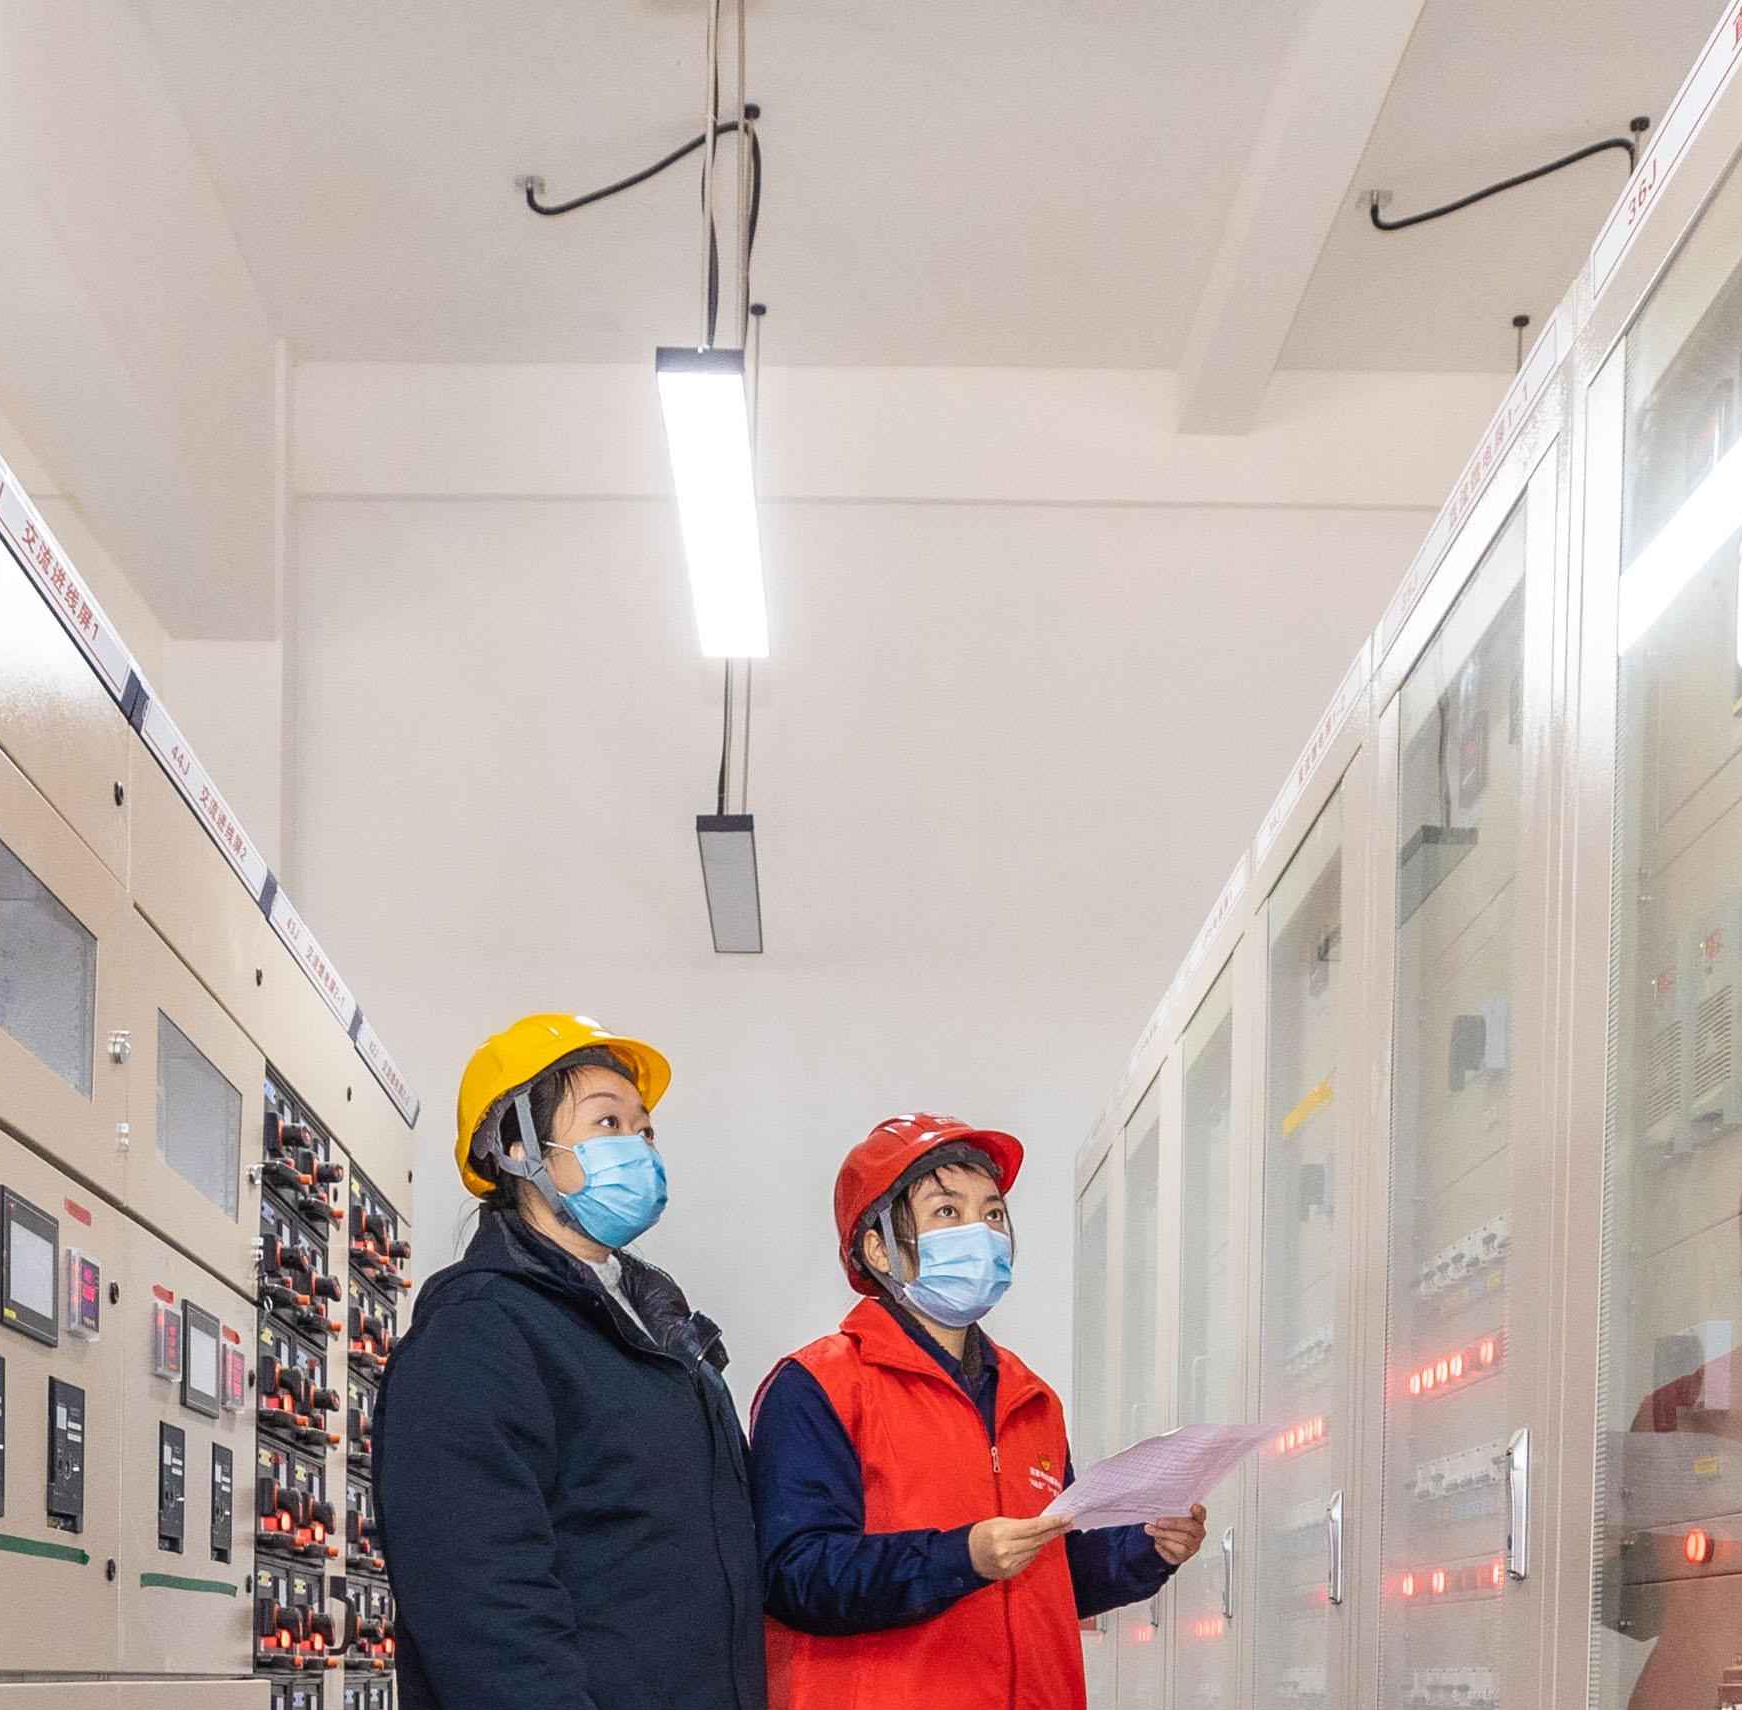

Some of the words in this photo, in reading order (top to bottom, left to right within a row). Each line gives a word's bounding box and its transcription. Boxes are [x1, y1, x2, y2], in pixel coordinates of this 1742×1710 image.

[1628, 160, 1656, 226] 36J
[21, 522, 100, 641] 交流进线屏1
[171, 745, 191, 777] 44J
